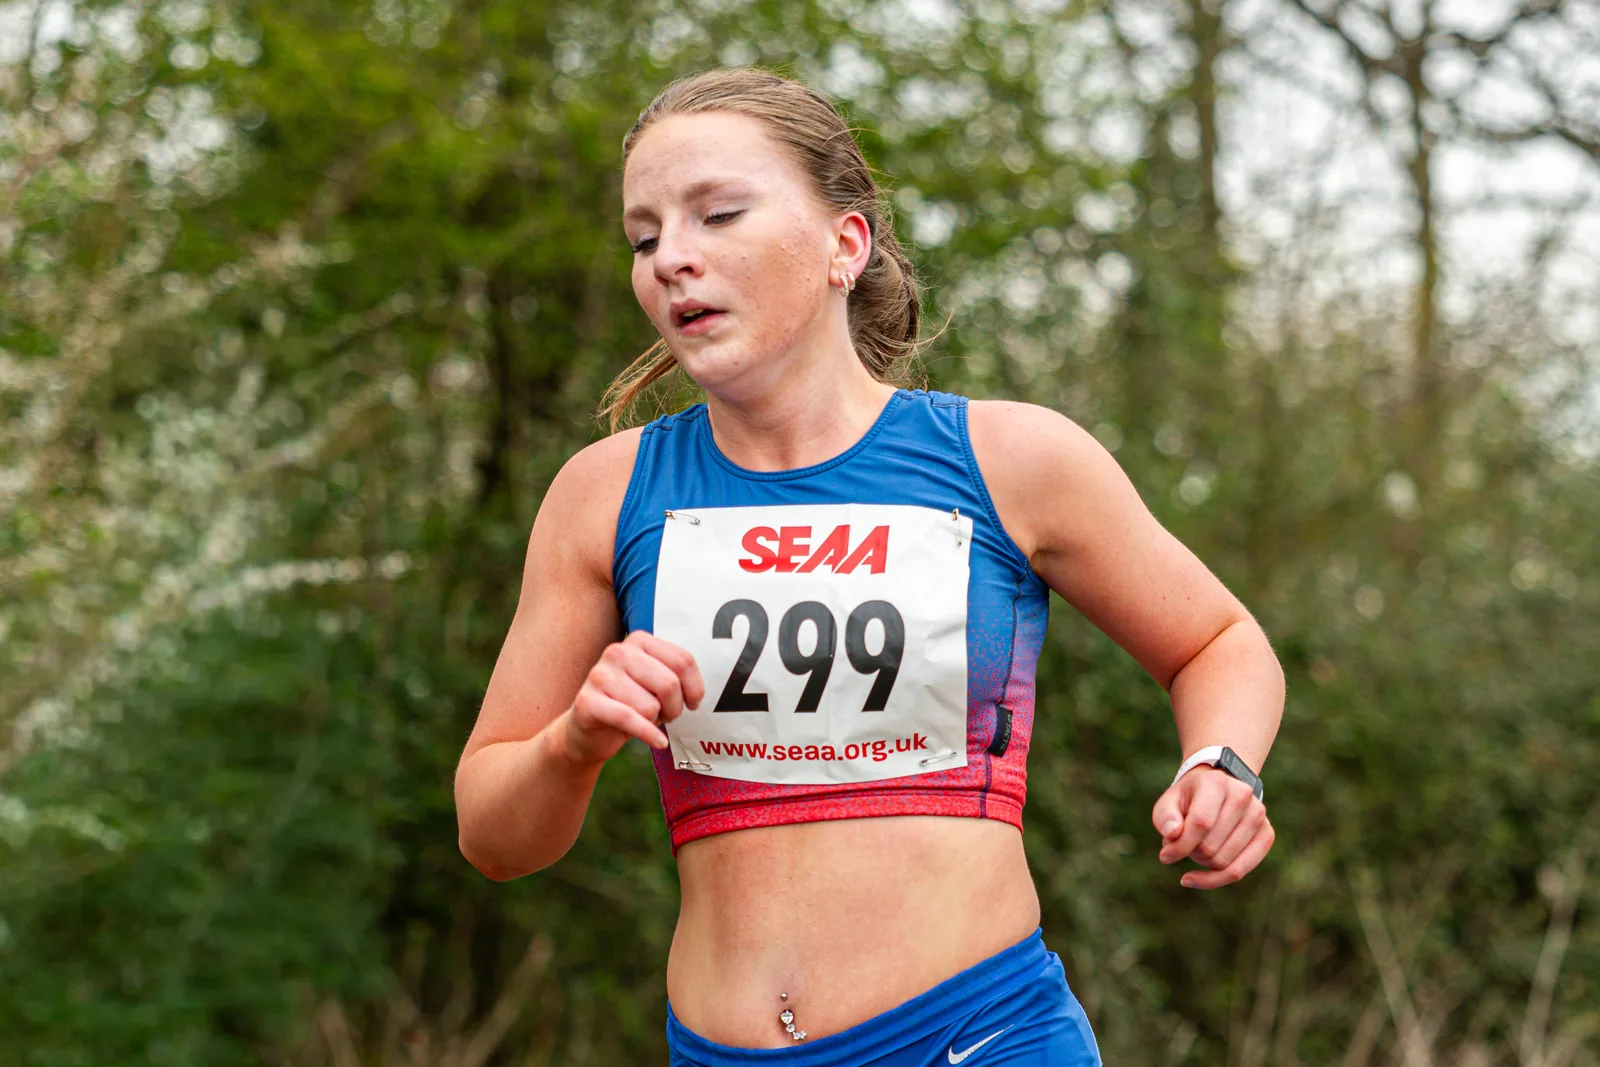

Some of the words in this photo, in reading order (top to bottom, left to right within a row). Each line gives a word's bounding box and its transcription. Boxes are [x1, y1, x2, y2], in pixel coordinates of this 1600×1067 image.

[738, 524, 890, 574] SEAA
[712, 598, 905, 713] 299
[699, 733, 928, 762] www.seaa.org.uk
[1000, 723, 1011, 751] TACTIC
